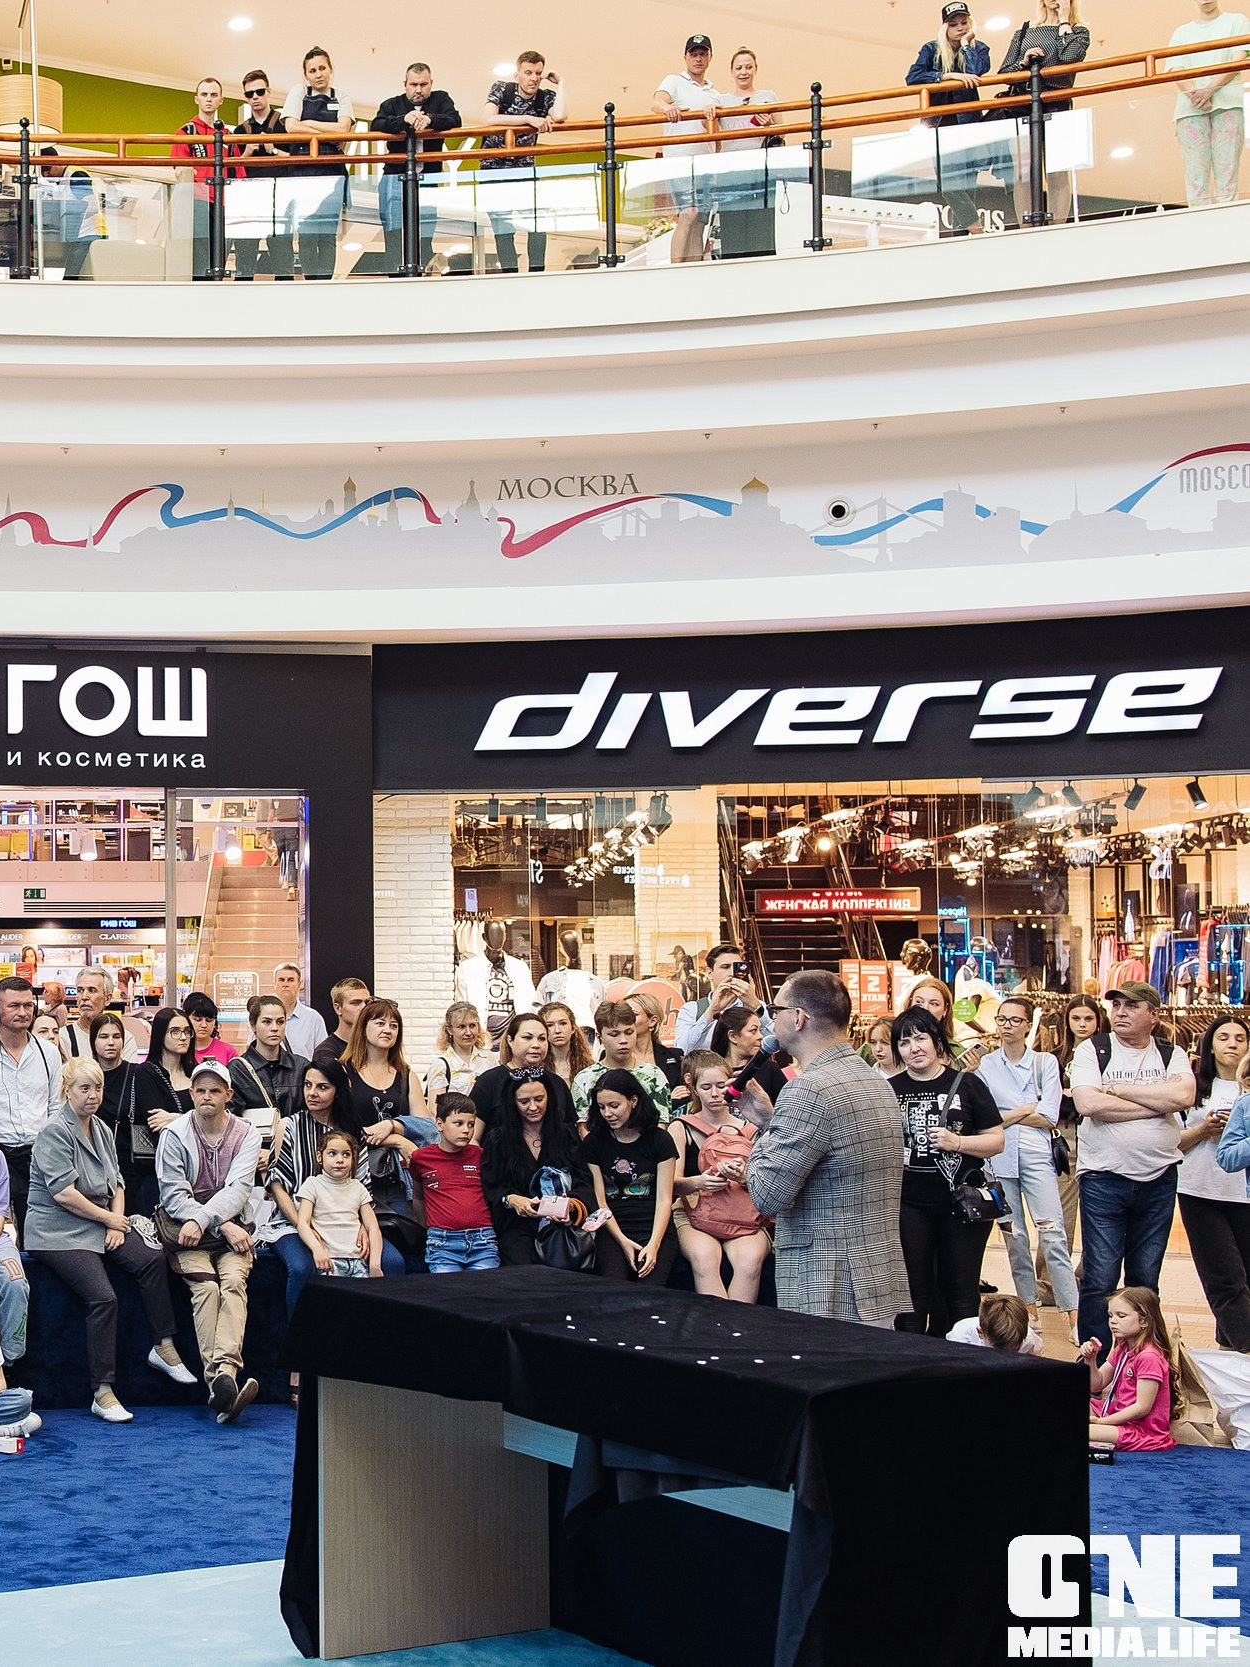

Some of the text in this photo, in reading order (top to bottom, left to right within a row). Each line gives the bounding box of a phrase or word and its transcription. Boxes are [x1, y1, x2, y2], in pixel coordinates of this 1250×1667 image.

[496, 473, 642, 501] МОСКВА
[7, 663, 208, 738] ГОШ
[473, 666, 1224, 753] diverse
[7, 751, 22, 766] и
[38, 750, 207, 769] косметика
[100, 920, 136, 928] РИВ ГОШ
[867, 975, 880, 992] 2
